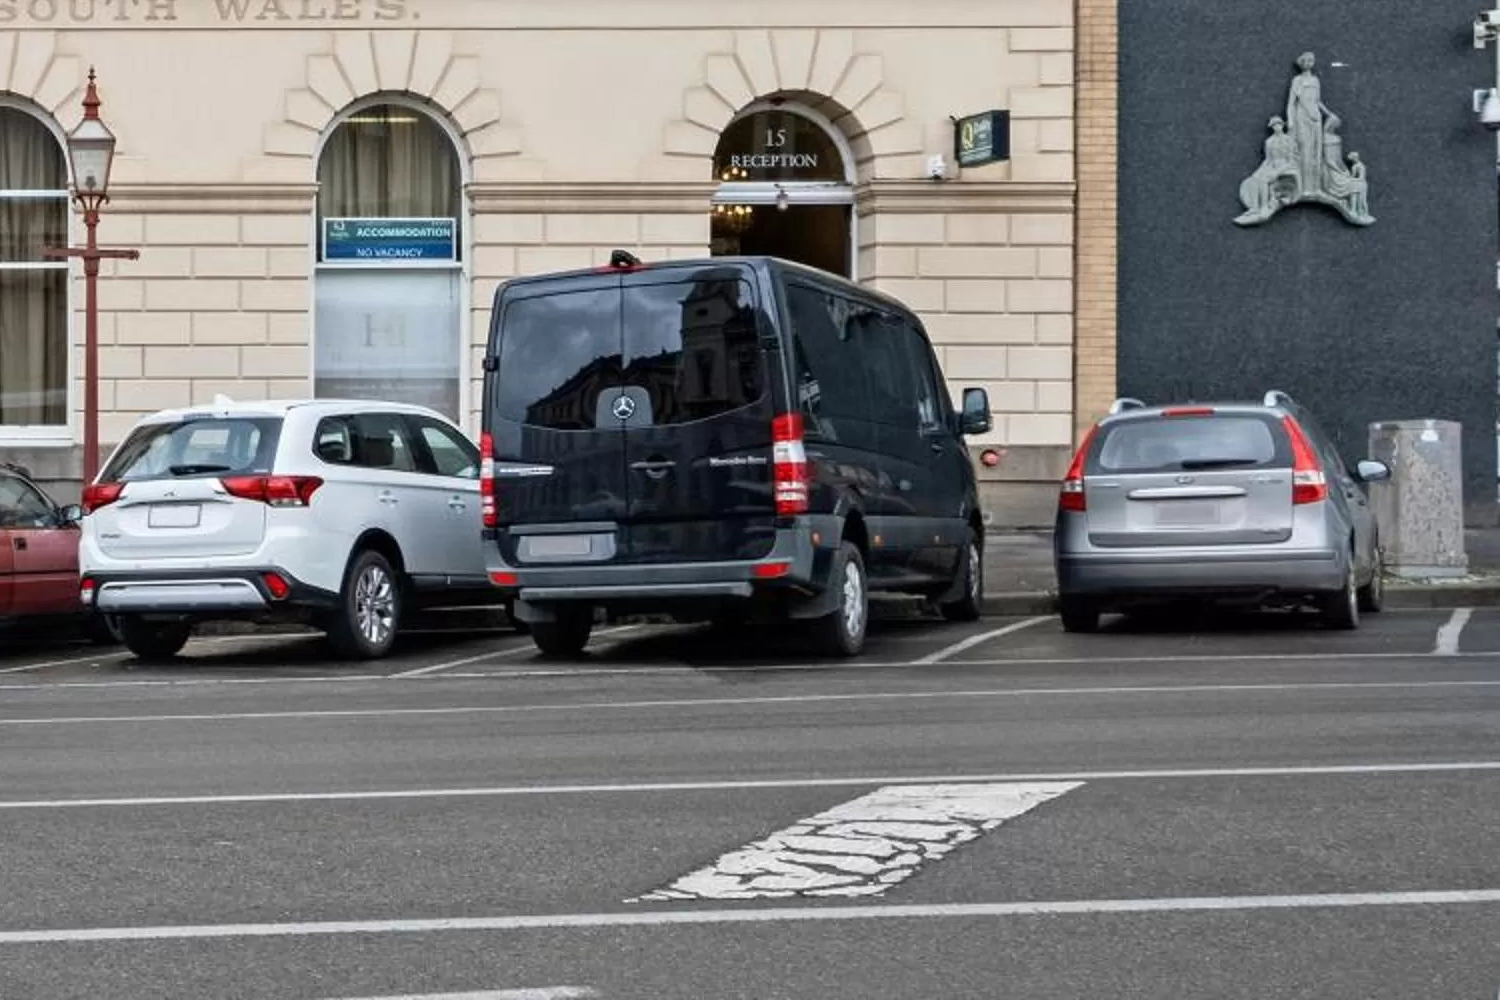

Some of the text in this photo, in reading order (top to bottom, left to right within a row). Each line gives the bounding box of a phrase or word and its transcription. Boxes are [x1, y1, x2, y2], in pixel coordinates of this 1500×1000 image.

[764, 128, 787, 148] 15
[731, 153, 818, 168] RECEPTION
[356, 227, 451, 237] ACCOMMODATION
[357, 247, 422, 257] NO VACANCY
